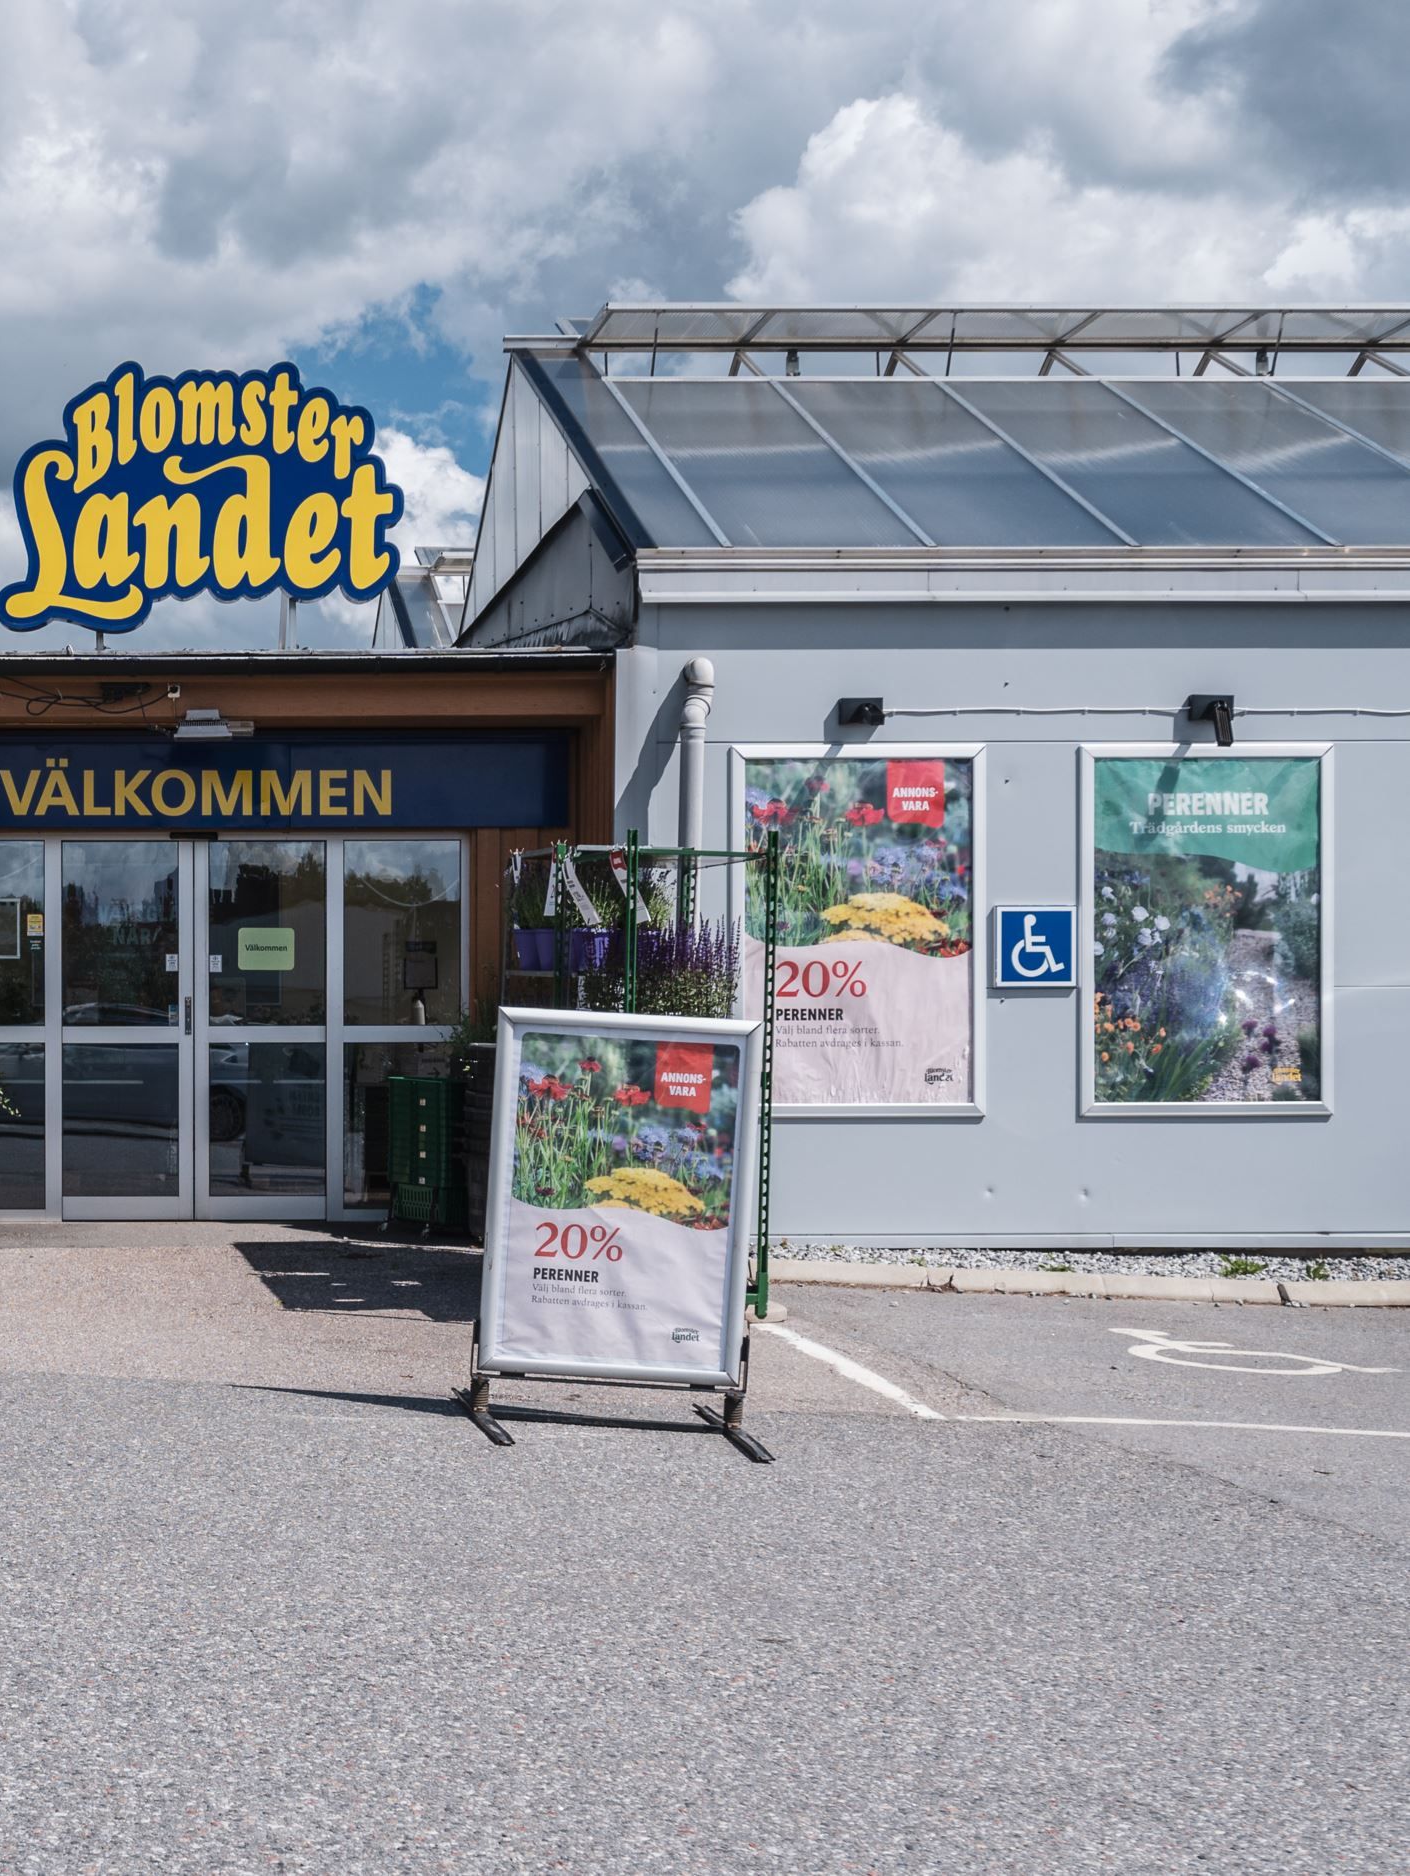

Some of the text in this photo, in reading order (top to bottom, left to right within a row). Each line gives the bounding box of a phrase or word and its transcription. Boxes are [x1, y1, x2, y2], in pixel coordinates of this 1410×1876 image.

[73, 372, 364, 494] Blomster
[5, 450, 394, 620] Landet
[0, 758, 392, 816] VÄLKOMMEN
[892, 786, 939, 798] ANNONS-
[901, 800, 930, 811] VARA
[1148, 791, 1269, 816] PERENNER
[1129, 820, 1287, 836] Trädgårdens smycken
[245, 943, 288, 952] Välkommen
[775, 960, 867, 998] 20%
[776, 1008, 844, 1021] PERENNER
[776, 1025, 880, 1036] Välj bland flera sorter.
[775, 1038, 817, 1048] Rabatten
[820, 1038, 861, 1049] avdrages
[870, 1038, 904, 1048] kassan.
[661, 1071, 706, 1084] ANNONS-
[669, 1085, 697, 1097] VARA
[534, 1221, 623, 1262] 20%
[533, 1267, 599, 1283] PERENNER
[532, 1283, 627, 1298] Välj bland flera sorter.
[531, 1294, 570, 1306] Rabatten
[571, 1297, 609, 1309] avdrages
[617, 1300, 648, 1311] kassan.
